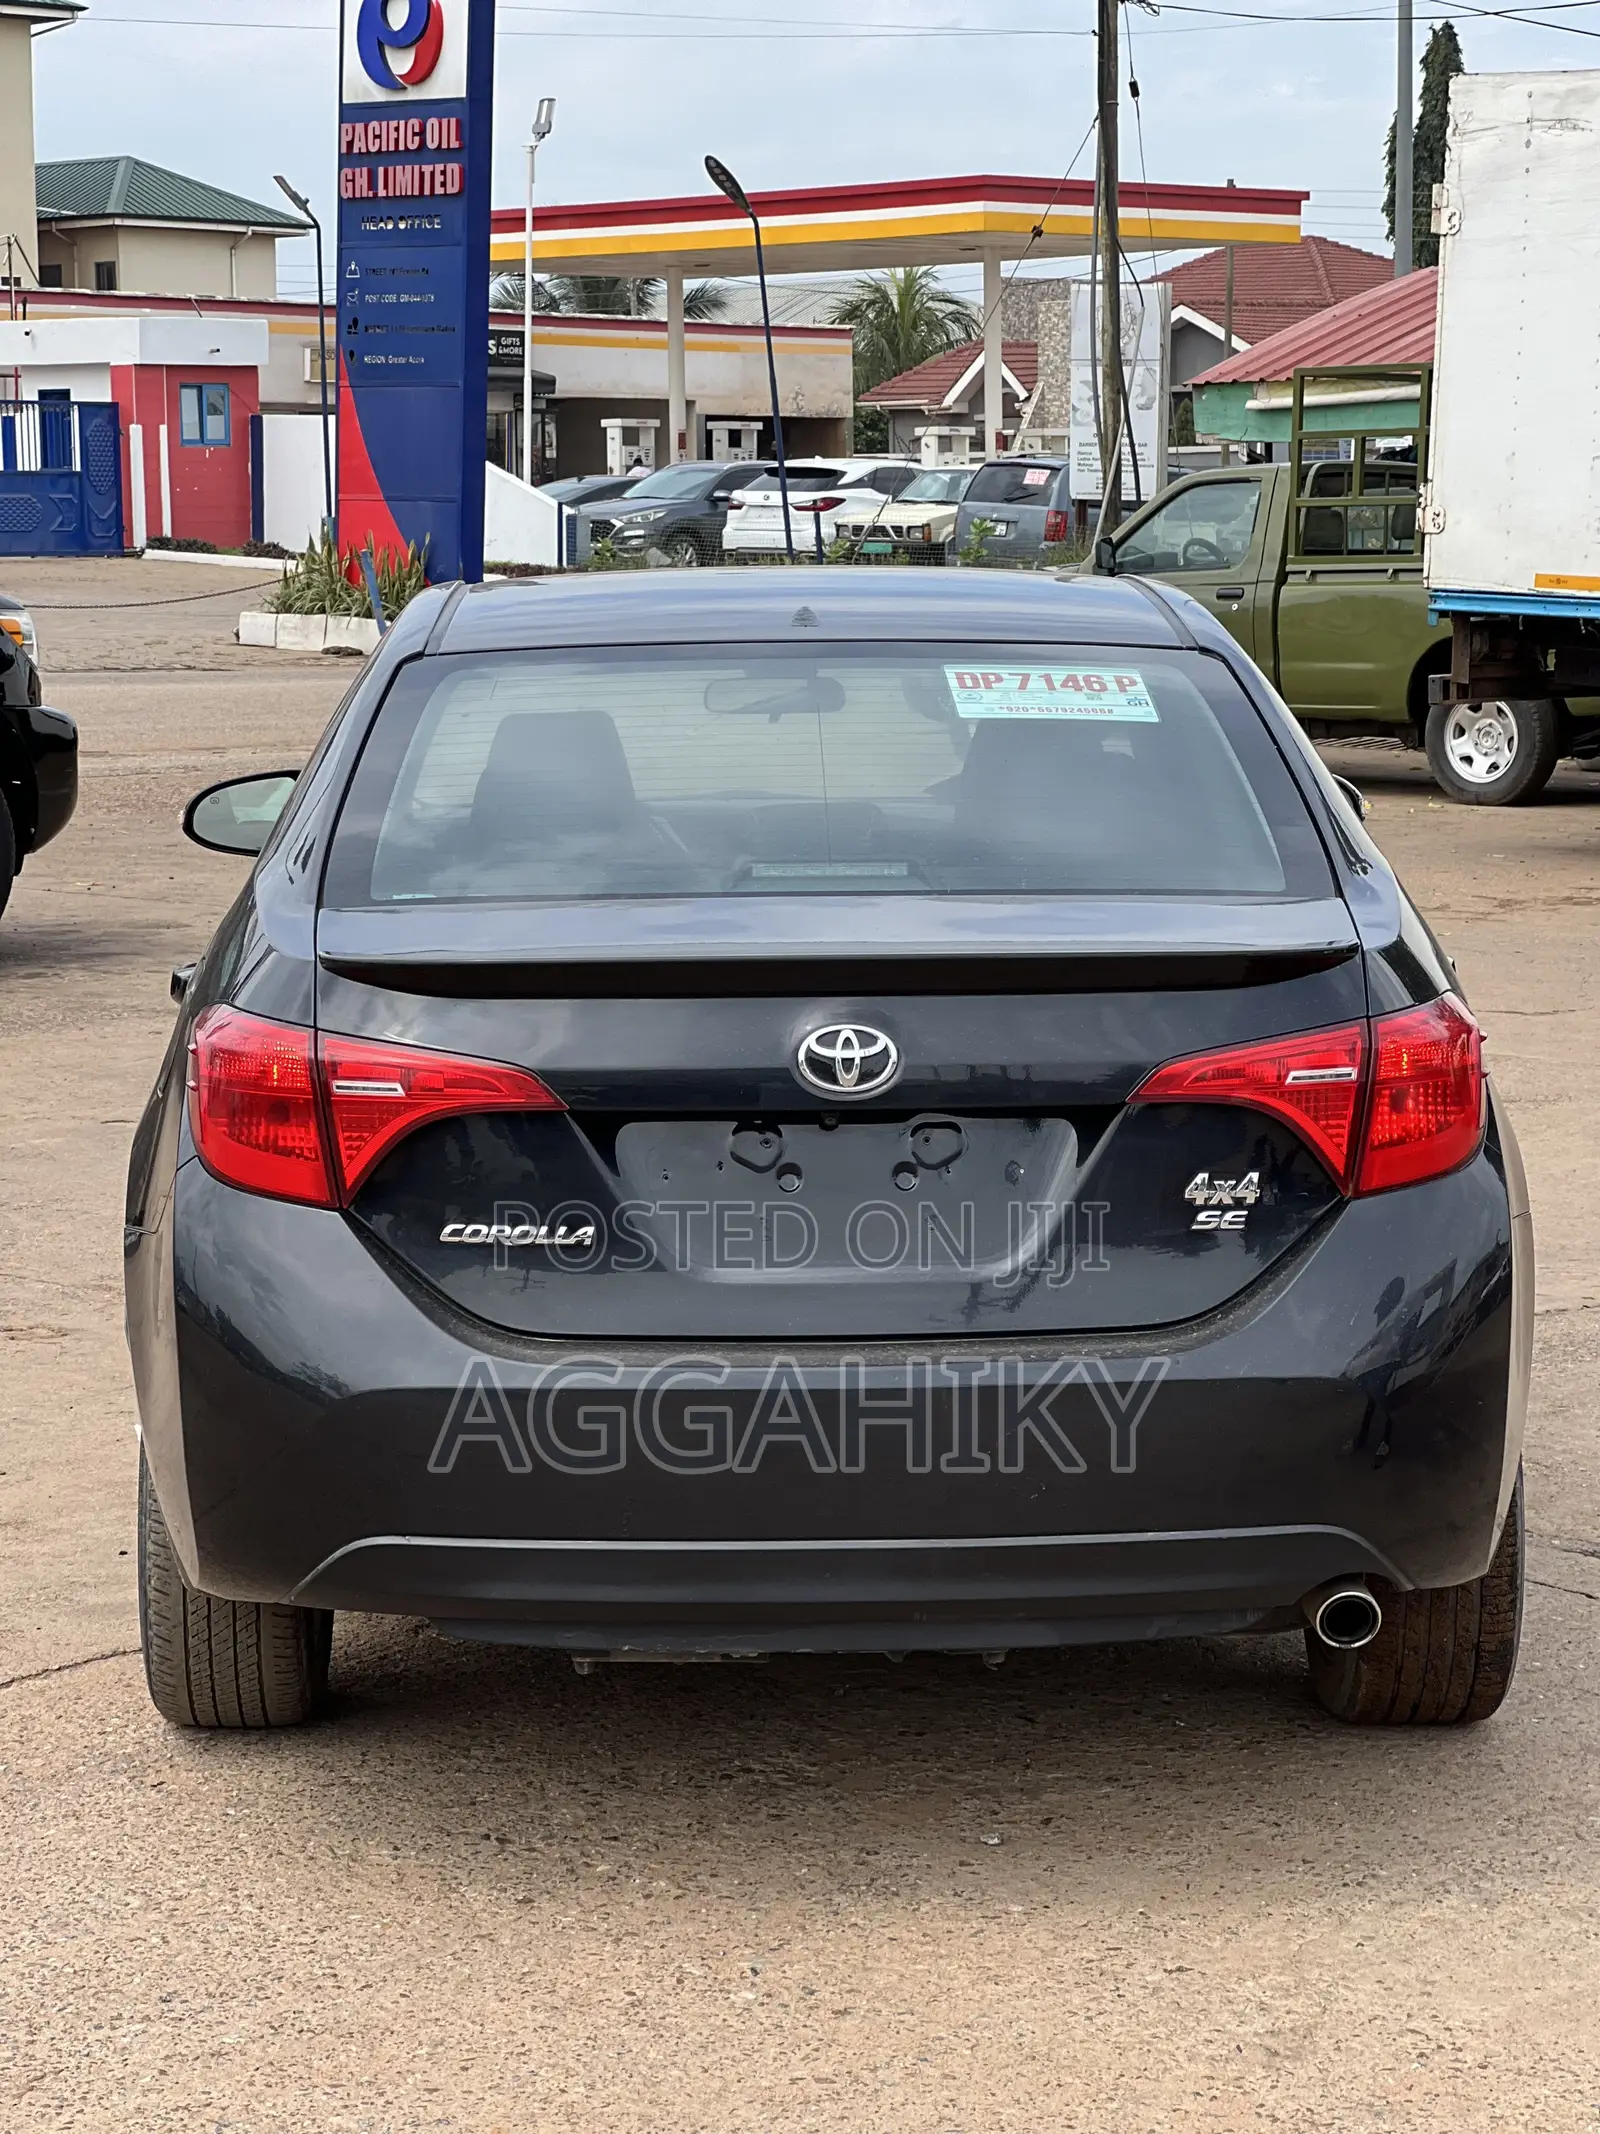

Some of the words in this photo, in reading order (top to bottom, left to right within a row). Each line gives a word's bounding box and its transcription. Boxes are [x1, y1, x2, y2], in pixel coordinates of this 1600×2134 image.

[340, 118, 423, 154] PACIFIC
[426, 117, 463, 150] OIL
[340, 166, 374, 199] GH.
[377, 162, 464, 197] LIMITED
[361, 215, 394, 230] HEAD
[398, 214, 442, 229] OFFICE
[500, 337, 520, 346] GIFTS
[954, 672, 1004, 690] DP
[1008, 672, 1108, 693] 7146
[1113, 675, 1138, 693] P
[1184, 1171, 1261, 1206] 4x4
[1191, 1210, 1249, 1230] SE
[439, 1223, 597, 1247] COROLLA
